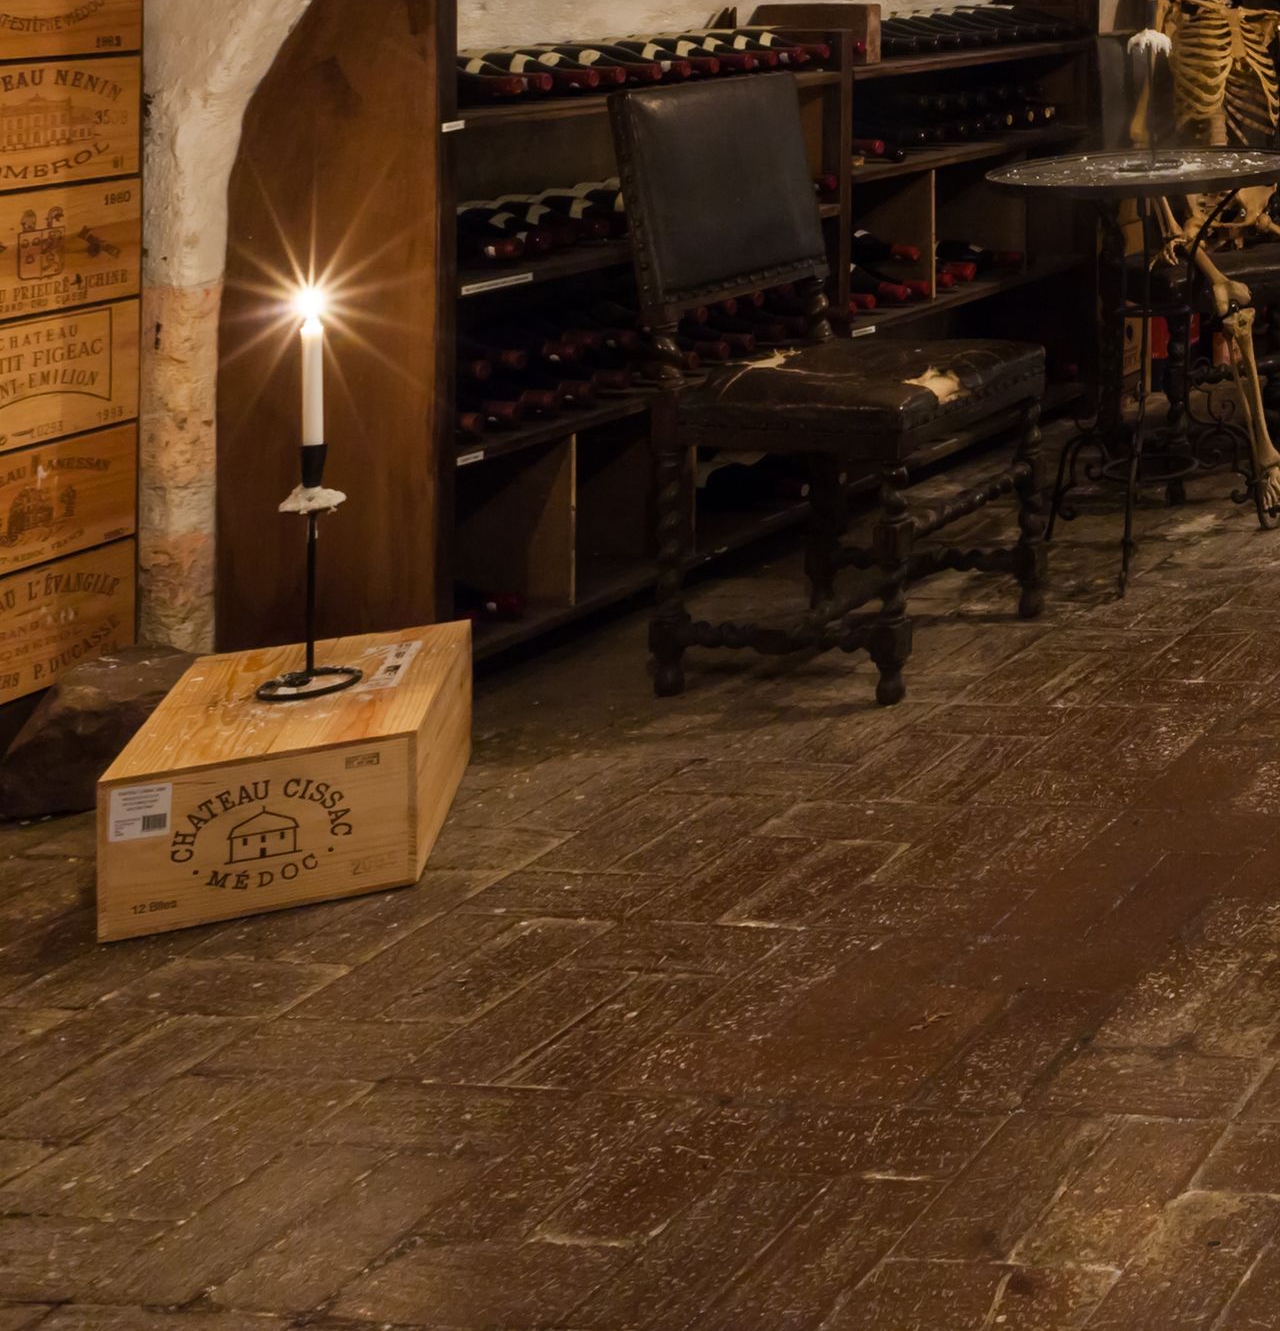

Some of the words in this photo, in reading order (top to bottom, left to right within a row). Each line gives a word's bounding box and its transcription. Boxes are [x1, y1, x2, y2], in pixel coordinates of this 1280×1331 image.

[53, 68, 123, 102] NENIN
[32, 337, 105, 368] FIGEAC
[170, 778, 272, 865] CHATEAU
[282, 777, 354, 838] CISSAC
[205, 852, 320, 891] MÉDOC
[131, 903, 147, 916] 12
